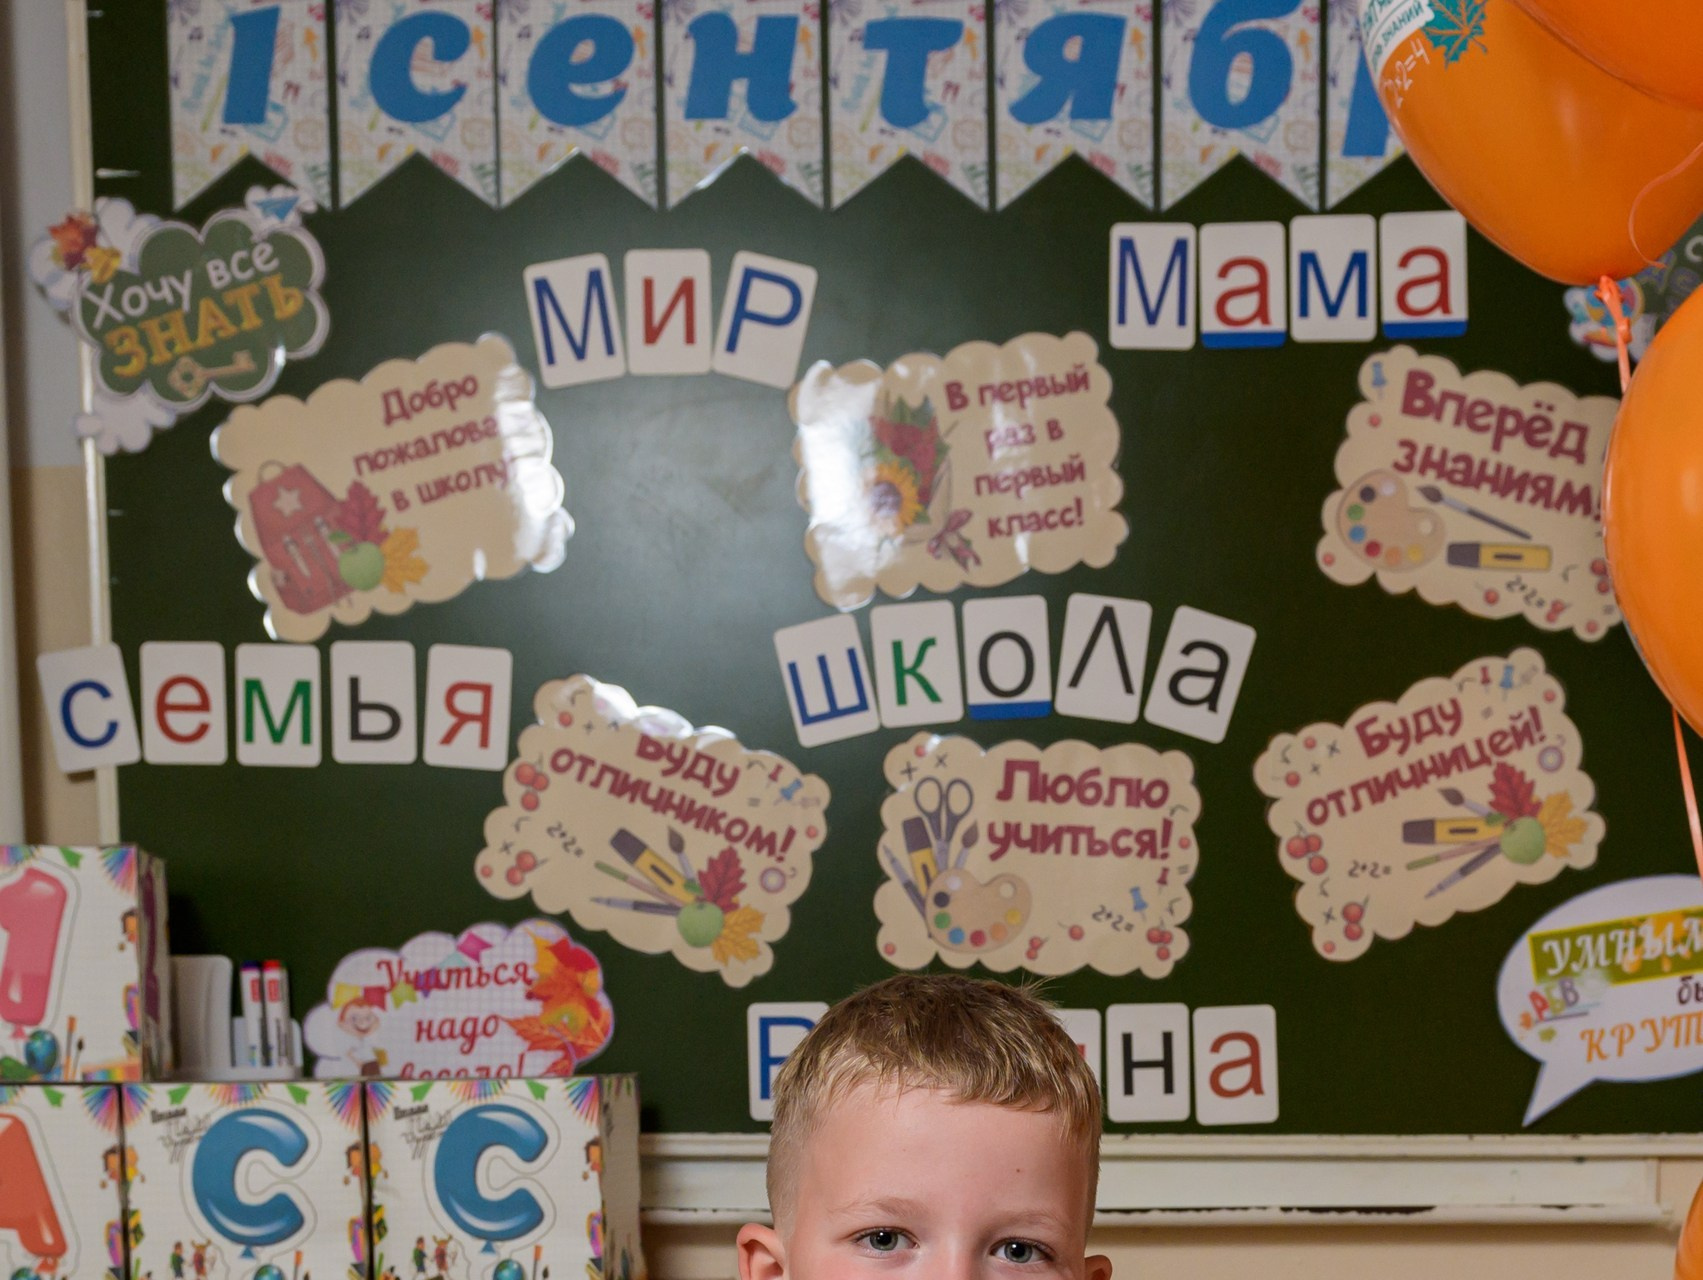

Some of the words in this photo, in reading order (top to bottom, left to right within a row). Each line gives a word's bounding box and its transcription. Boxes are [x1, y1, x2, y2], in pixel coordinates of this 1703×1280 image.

[222, 5, 281, 124] 1
[82, 269, 193, 329] Хочу
[1116, 236, 1453, 328] Мама
[105, 272, 305, 378] ЗНАТЬ
[381, 374, 479, 427] Добро
[945, 380, 970, 412] В
[978, 363, 1090, 410] первый
[984, 423, 1036, 460] раз
[1046, 417, 1065, 441] в
[1401, 368, 1591, 466] Вперёд
[391, 488, 411, 513] в
[974, 453, 1086, 500] первый
[987, 496, 1085, 539] класс!
[1354, 697, 1463, 759] Буду
[995, 758, 1171, 810] Люблю
[1306, 705, 1547, 826] отличницей!
[549, 746, 796, 862] отличником!
[987, 817, 1174, 862] учиться!
[376, 957, 534, 992] Учиться
[415, 1013, 501, 1055] надо
